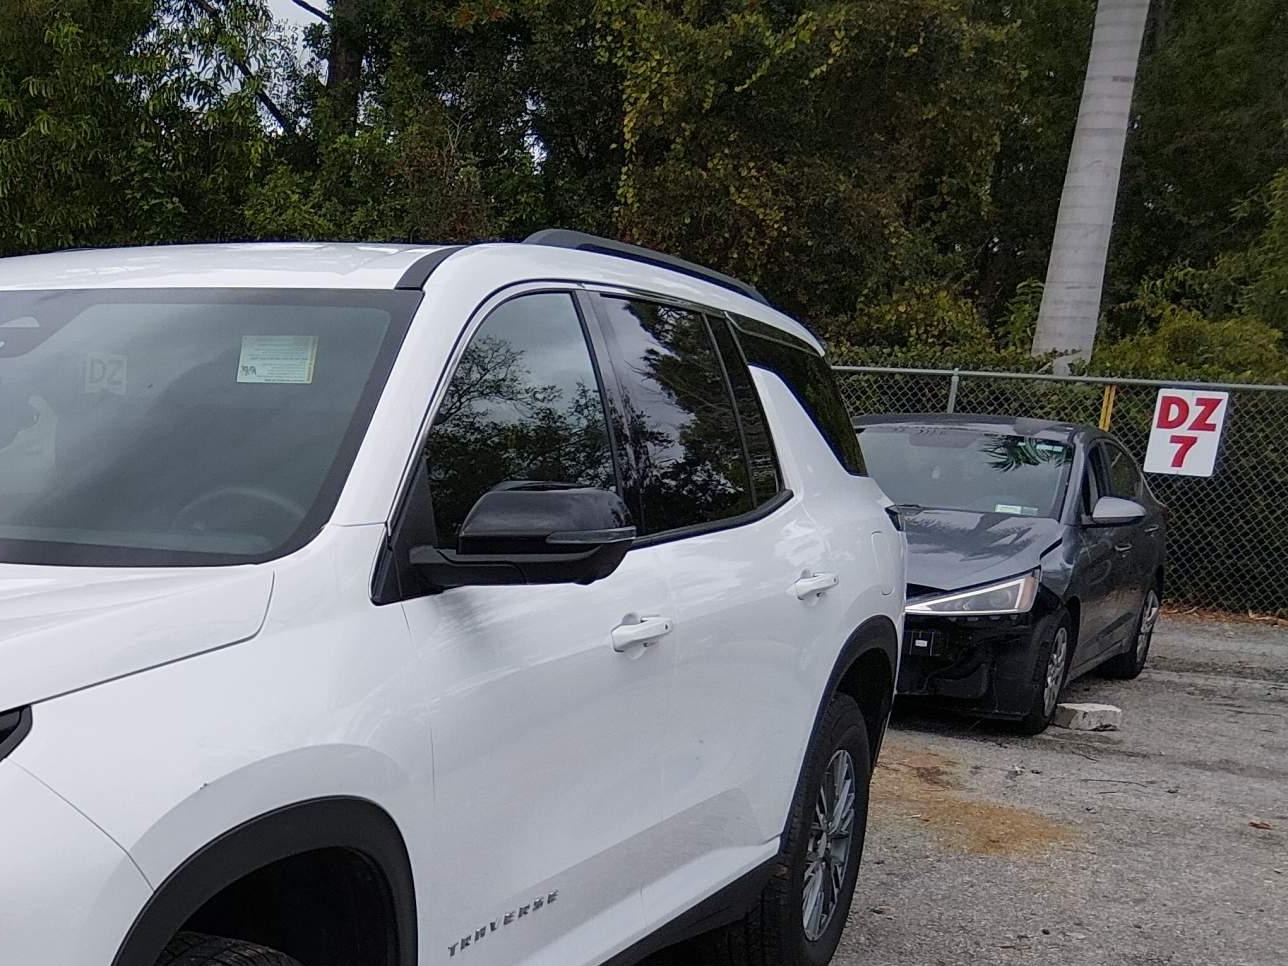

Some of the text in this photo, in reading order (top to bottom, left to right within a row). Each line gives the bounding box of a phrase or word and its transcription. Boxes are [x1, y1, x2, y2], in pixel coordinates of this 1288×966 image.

[89, 358, 123, 385] DZ
[1156, 395, 1224, 432] DZ
[1169, 434, 1198, 468] 7
[447, 889, 559, 958] TRAVERSE
